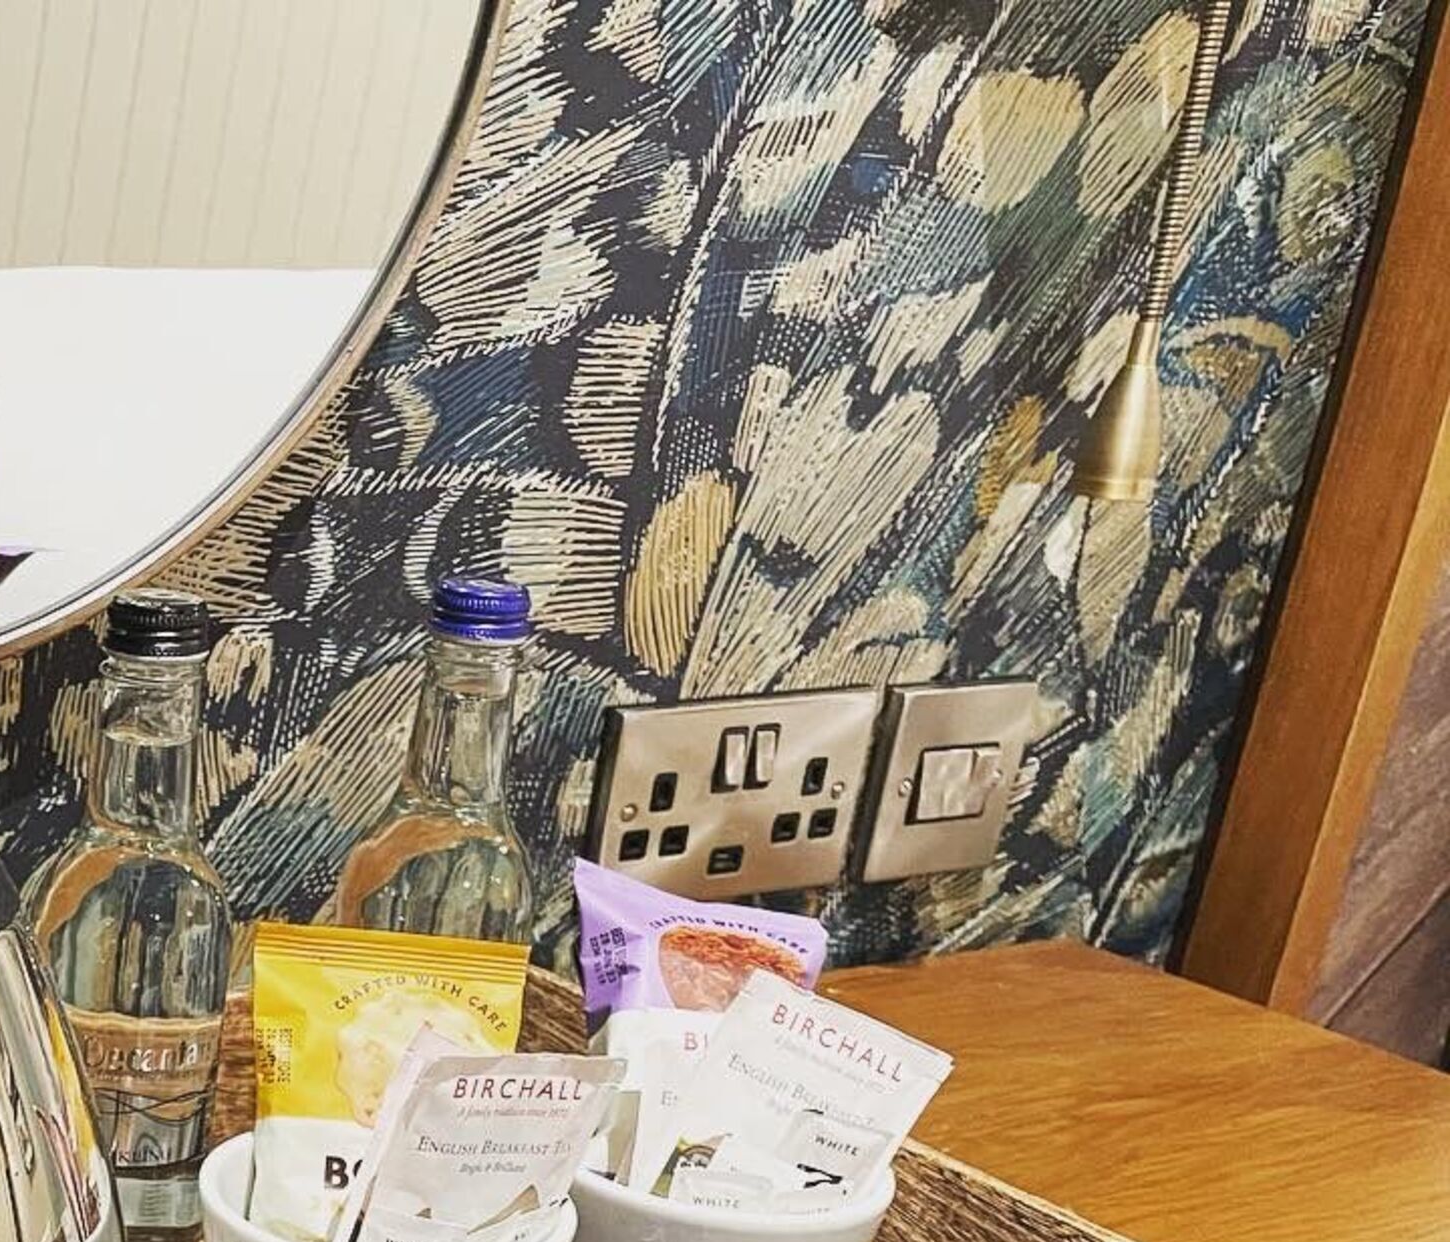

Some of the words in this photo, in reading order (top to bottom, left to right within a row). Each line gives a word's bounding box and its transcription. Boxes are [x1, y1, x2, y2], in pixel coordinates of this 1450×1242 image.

[334, 974, 406, 1010] CRAFTED
[415, 973, 462, 998] WITH
[468, 995, 507, 1032] CARE
[772, 1003, 903, 1083] BIRCHALL
[452, 1077, 583, 1101] BIRCHALL
[814, 1135, 859, 1157] WHITE
[693, 1195, 741, 1209] WHITE
